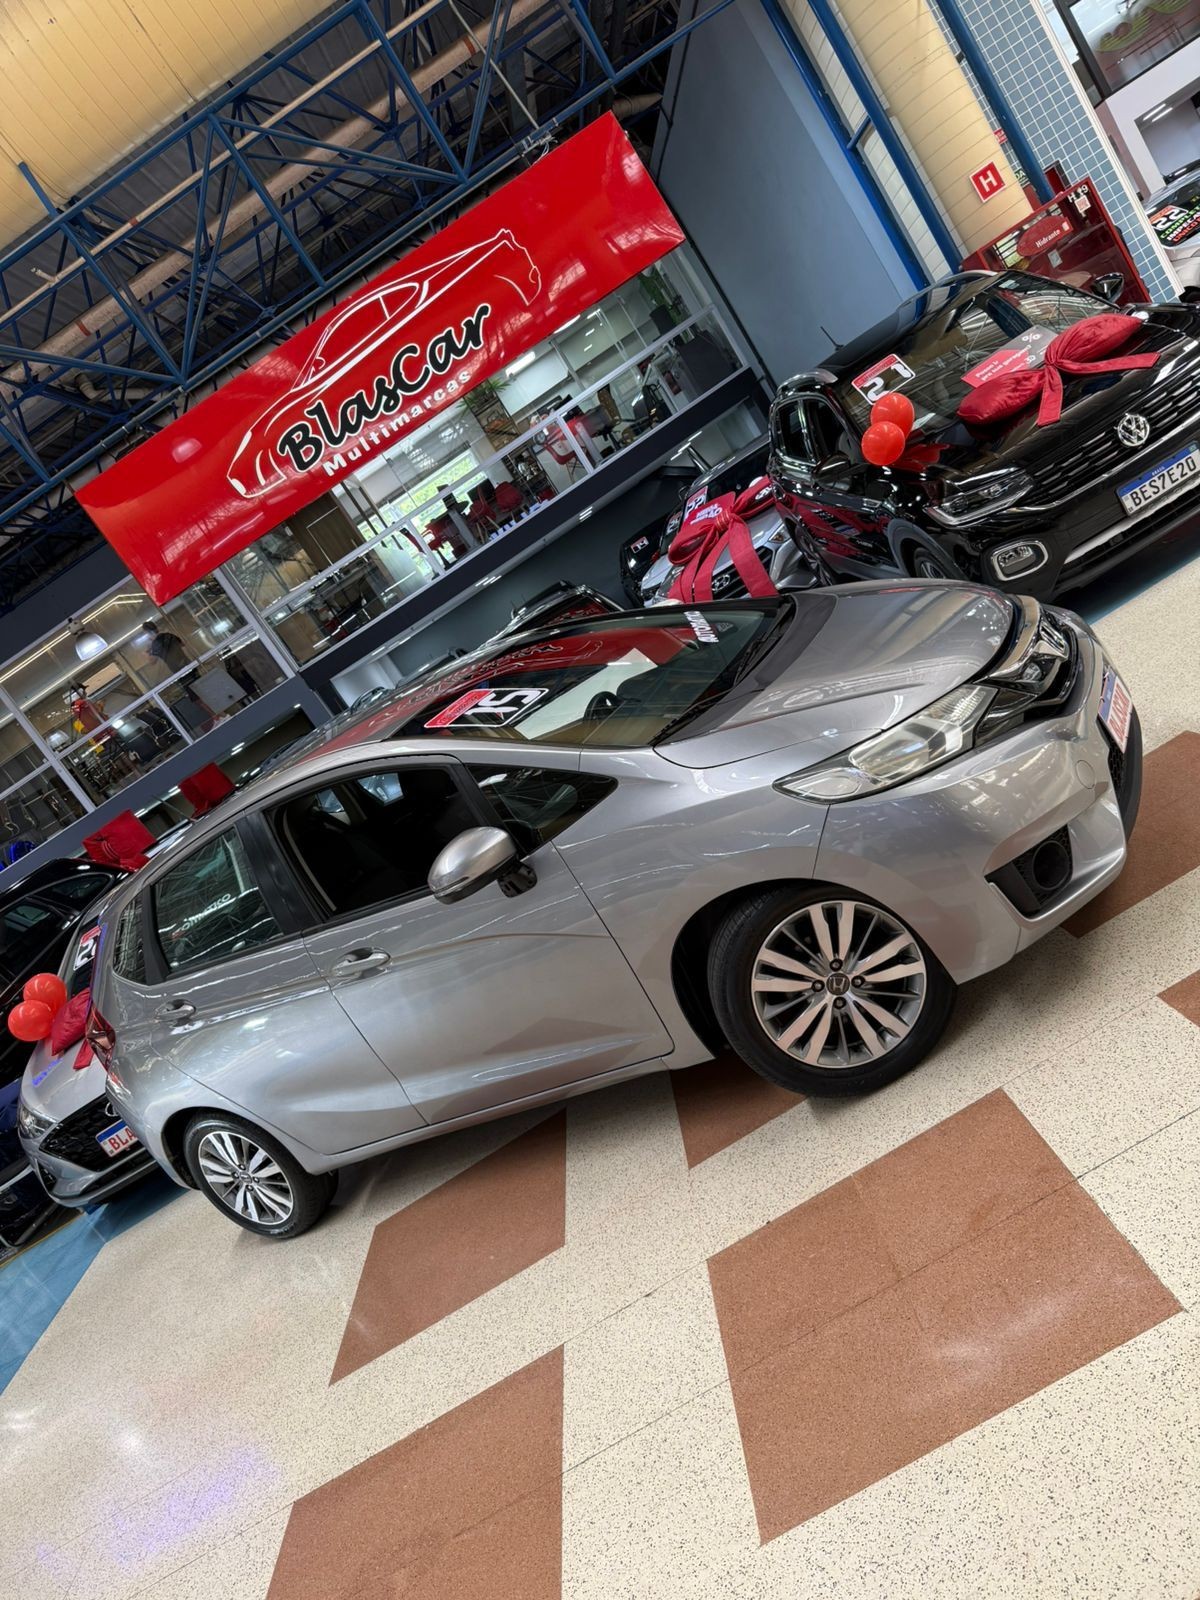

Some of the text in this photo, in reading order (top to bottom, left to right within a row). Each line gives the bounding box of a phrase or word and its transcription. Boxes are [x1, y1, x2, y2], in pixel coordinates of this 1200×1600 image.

[979, 170, 998, 192] H
[1035, 229, 1061, 248] Hidrante
[277, 303, 491, 472] BlasCar
[867, 363, 912, 401] 21
[322, 370, 473, 477] Multimarcas
[1129, 456, 1197, 507] BES7E20
[464, 690, 541, 715] 15
